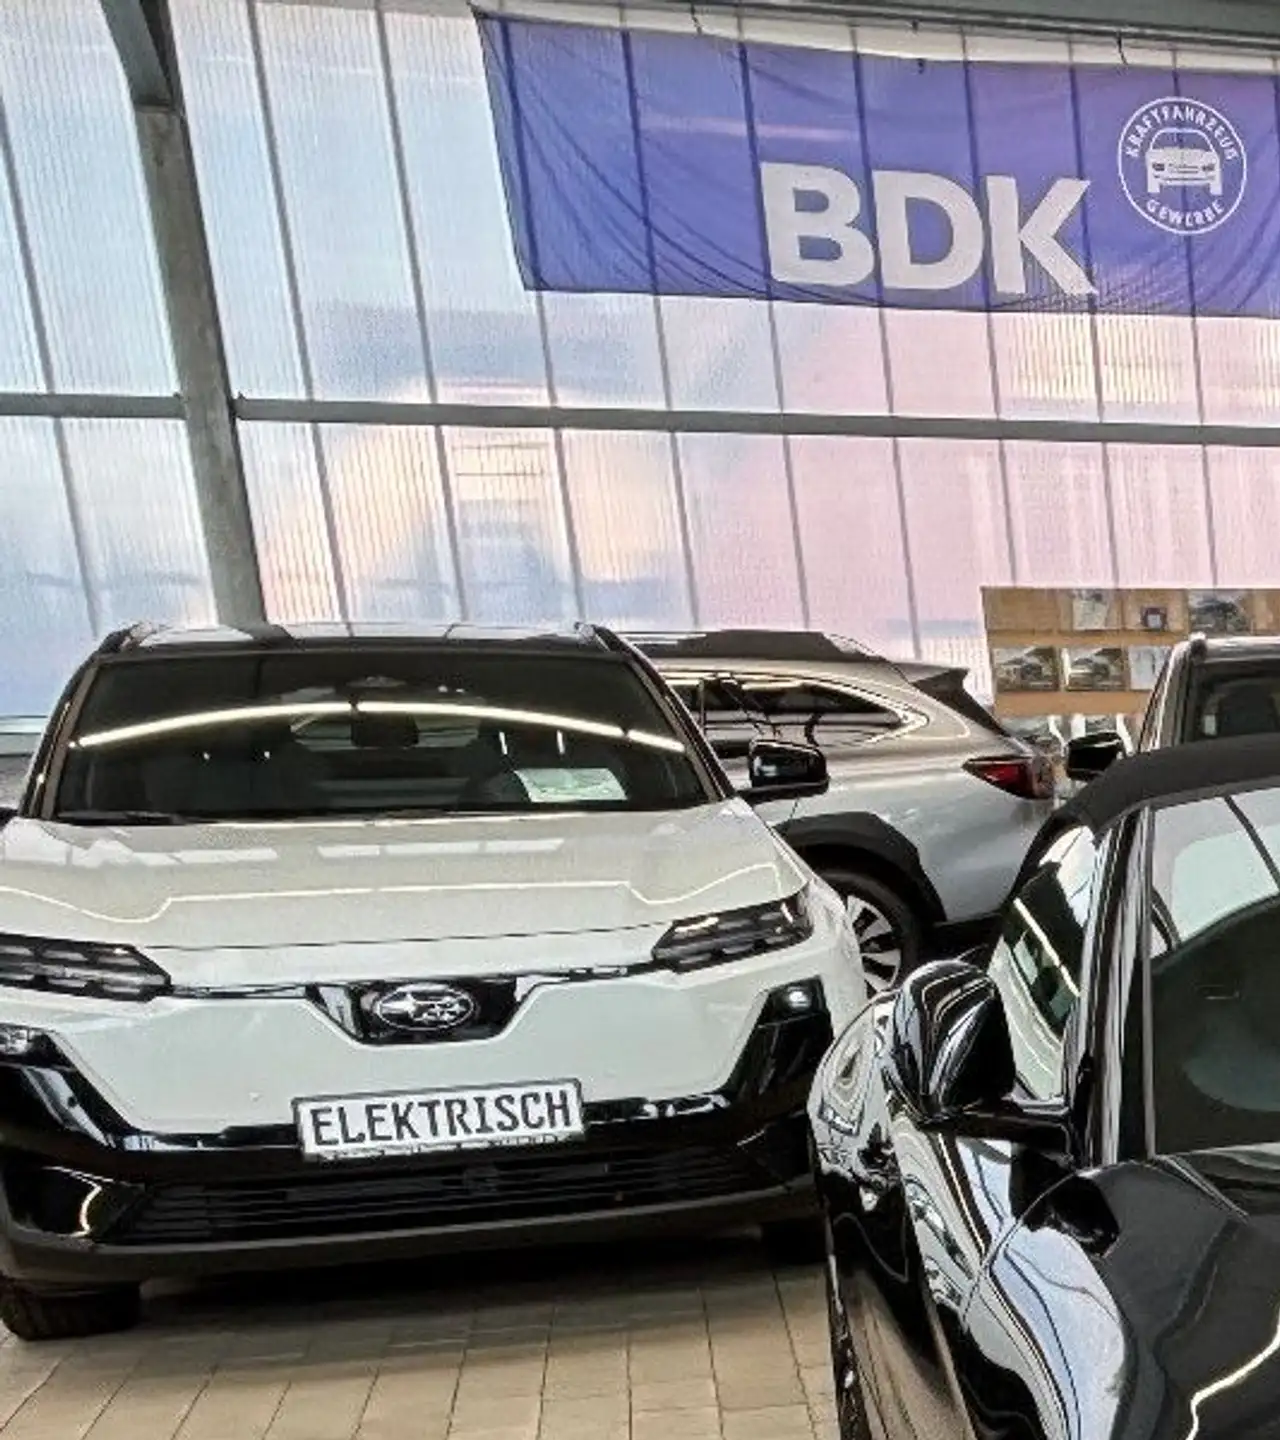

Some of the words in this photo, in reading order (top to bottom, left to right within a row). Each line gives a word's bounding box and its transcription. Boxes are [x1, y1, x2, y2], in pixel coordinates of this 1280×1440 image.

[761, 161, 1098, 296] BDK
[1146, 199, 1224, 227] GEWERBE
[309, 1089, 572, 1146] ELEKTRISCH
